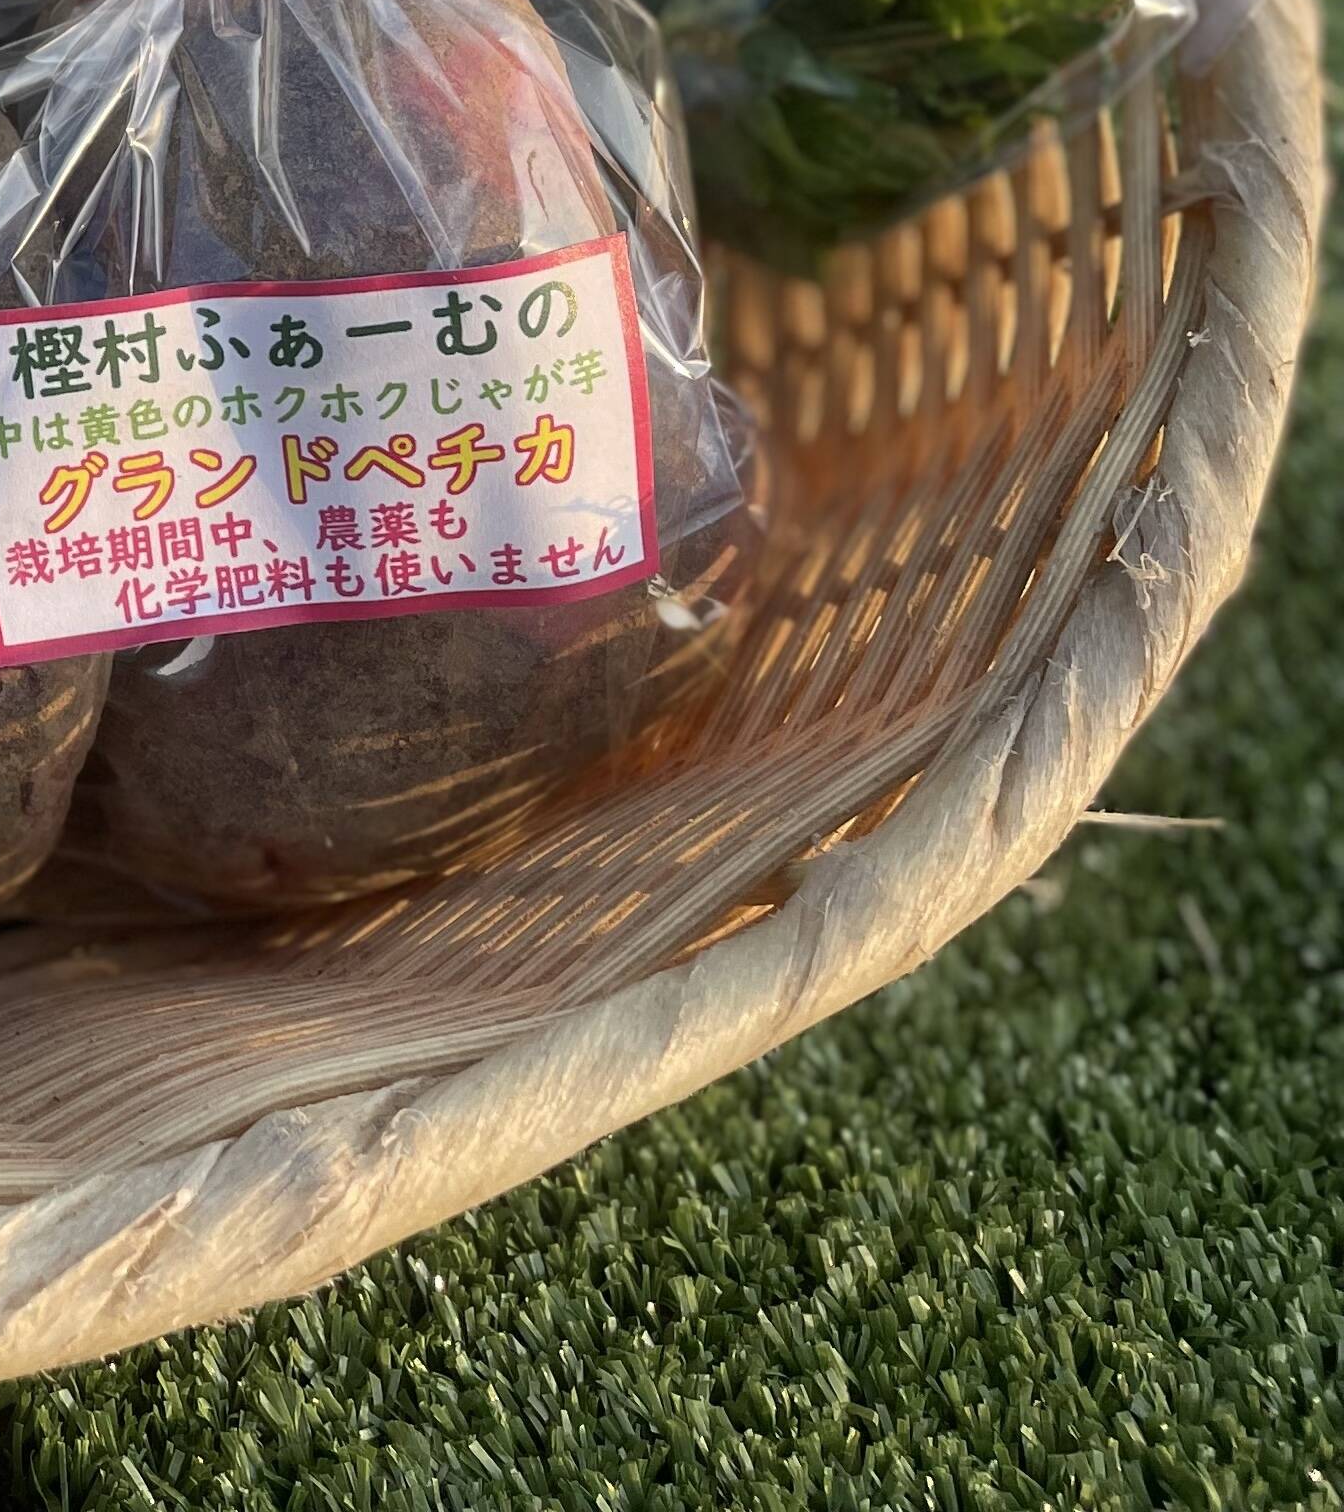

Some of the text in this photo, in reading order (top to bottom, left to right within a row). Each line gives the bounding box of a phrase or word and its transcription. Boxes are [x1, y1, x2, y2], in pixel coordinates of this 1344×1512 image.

[9, 280, 580, 400] 樫村ふぁーむの
[38, 414, 575, 534] グランドペチカ
[4, 499, 468, 588] 栽培期間中、農薬も
[114, 526, 625, 626] 化学肥料も使いません
